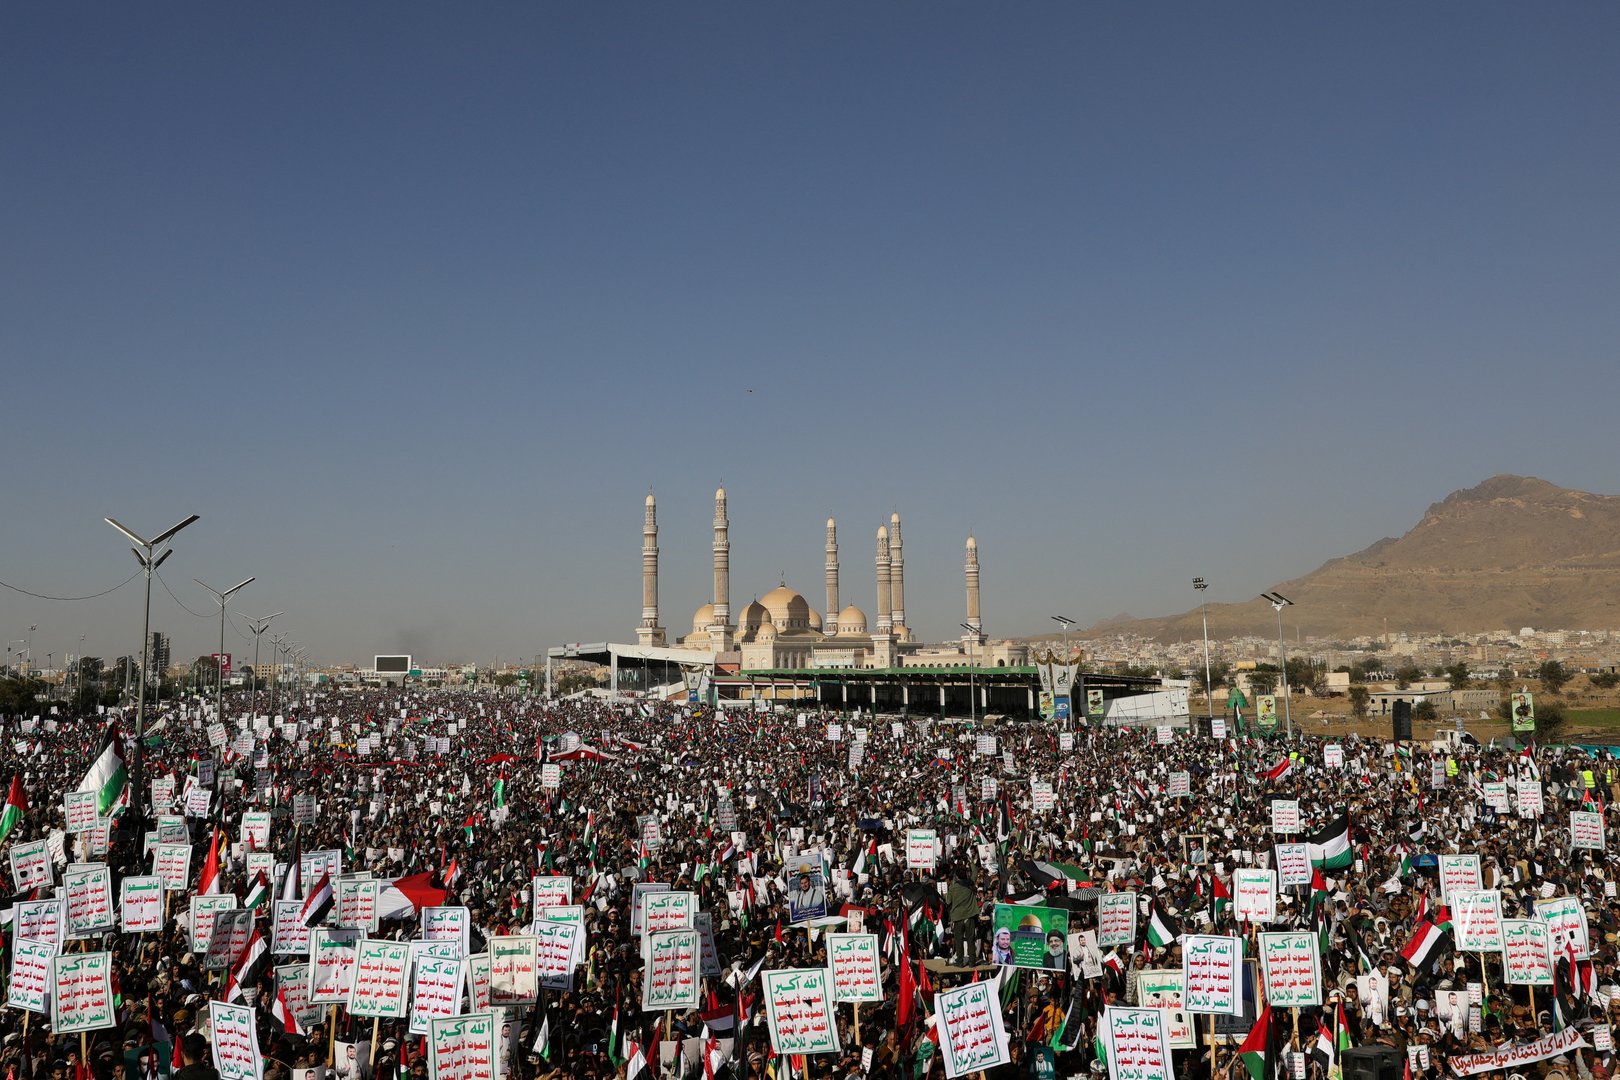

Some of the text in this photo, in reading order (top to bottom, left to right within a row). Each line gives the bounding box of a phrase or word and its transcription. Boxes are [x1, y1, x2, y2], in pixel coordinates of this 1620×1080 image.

[126, 880, 159, 893] قاطعوا
[1215, 942, 1232, 955] الله
[1294, 937, 1311, 949] الله
[388, 948, 406, 960] الله
[493, 942, 531, 959] قاطعوا
[1292, 953, 1312, 963] الموت
[384, 965, 403, 973] الموت
[1212, 960, 1232, 969] الموت
[1293, 966, 1313, 976] الموت
[85, 973, 104, 984] الموت
[382, 978, 401, 986] الموت
[803, 975, 822, 989] الله
[1212, 973, 1232, 982] الموت
[1270, 978, 1314, 989] اللعنة على اليهود
[85, 985, 106, 997] الموت
[356, 988, 400, 998] اللعنة على اليهود
[1188, 983, 1232, 994] اللعنة على اليهود
[1296, 988, 1315, 1003] النصر
[59, 998, 107, 1013] اللعنة على اليهود
[378, 1000, 399, 1014] النصر
[1212, 995, 1232, 1009] النصر
[87, 1009, 108, 1025] النصر
[804, 1008, 826, 1020] الموت
[468, 1018, 491, 1035] الله
[811, 1021, 828, 1032] اللعنة
[1141, 1014, 1159, 1027] الله
[799, 1024, 810, 1035] على
[809, 1033, 831, 1050] النصر
[1140, 1032, 1160, 1041] الموت
[1554, 1035, 1563, 1049] ما
[1562, 1030, 1579, 1046] هذا
[467, 1040, 490, 1051] الموت
[1142, 1045, 1162, 1055] الموت
[1540, 1035, 1553, 1055] كنا
[1511, 1044, 1539, 1060] نتمناه
[468, 1055, 491, 1066] الموت
[1117, 1056, 1163, 1067] اللعنة على اليهود
